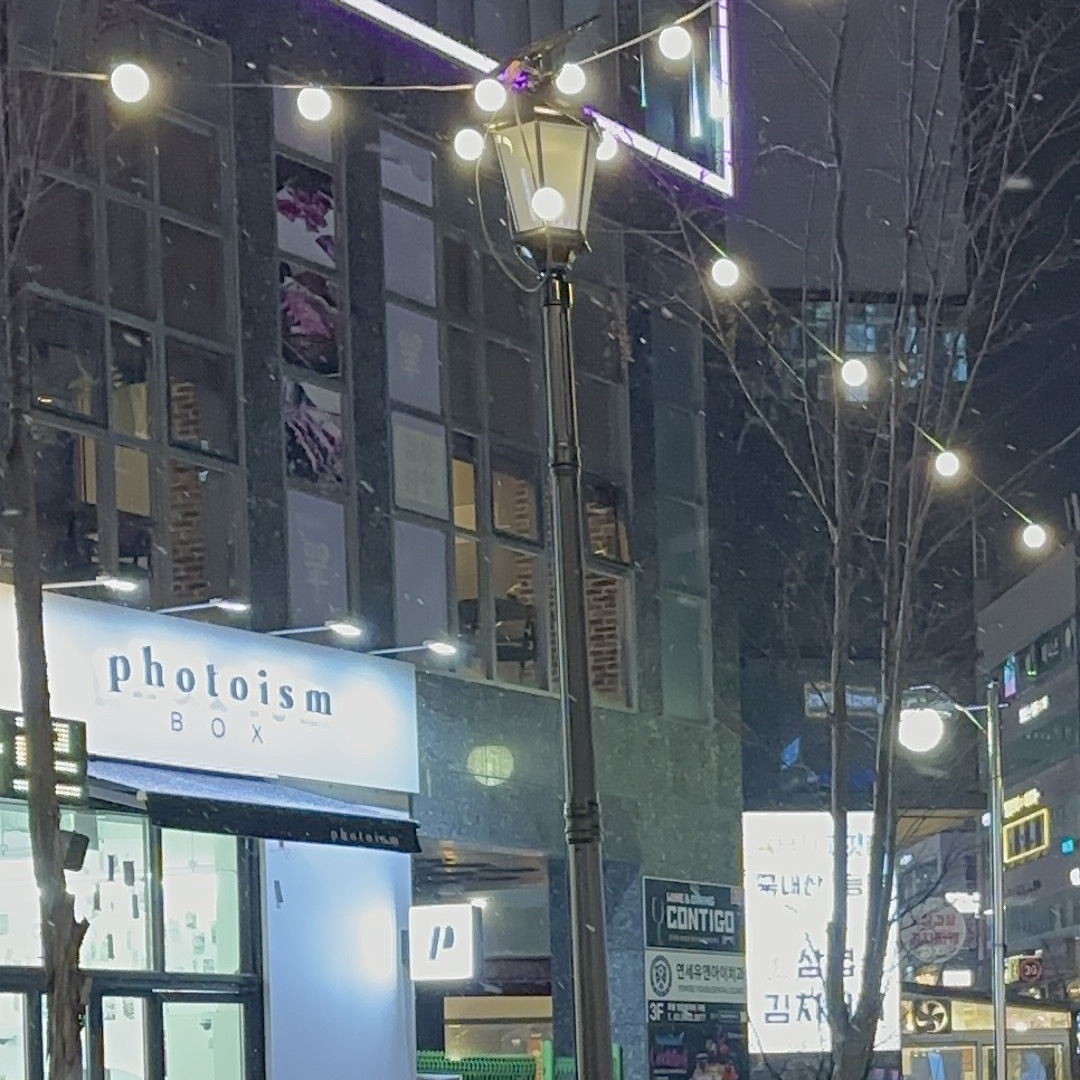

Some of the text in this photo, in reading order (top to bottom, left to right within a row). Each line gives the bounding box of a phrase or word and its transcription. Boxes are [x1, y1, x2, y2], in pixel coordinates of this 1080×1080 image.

[108, 645, 332, 715] photoism
[170, 711, 264, 744] BOX
[666, 905, 735, 933] CONTIGO
[1024, 965, 1037, 976] 30
[650, 1002, 664, 1022] 3F
